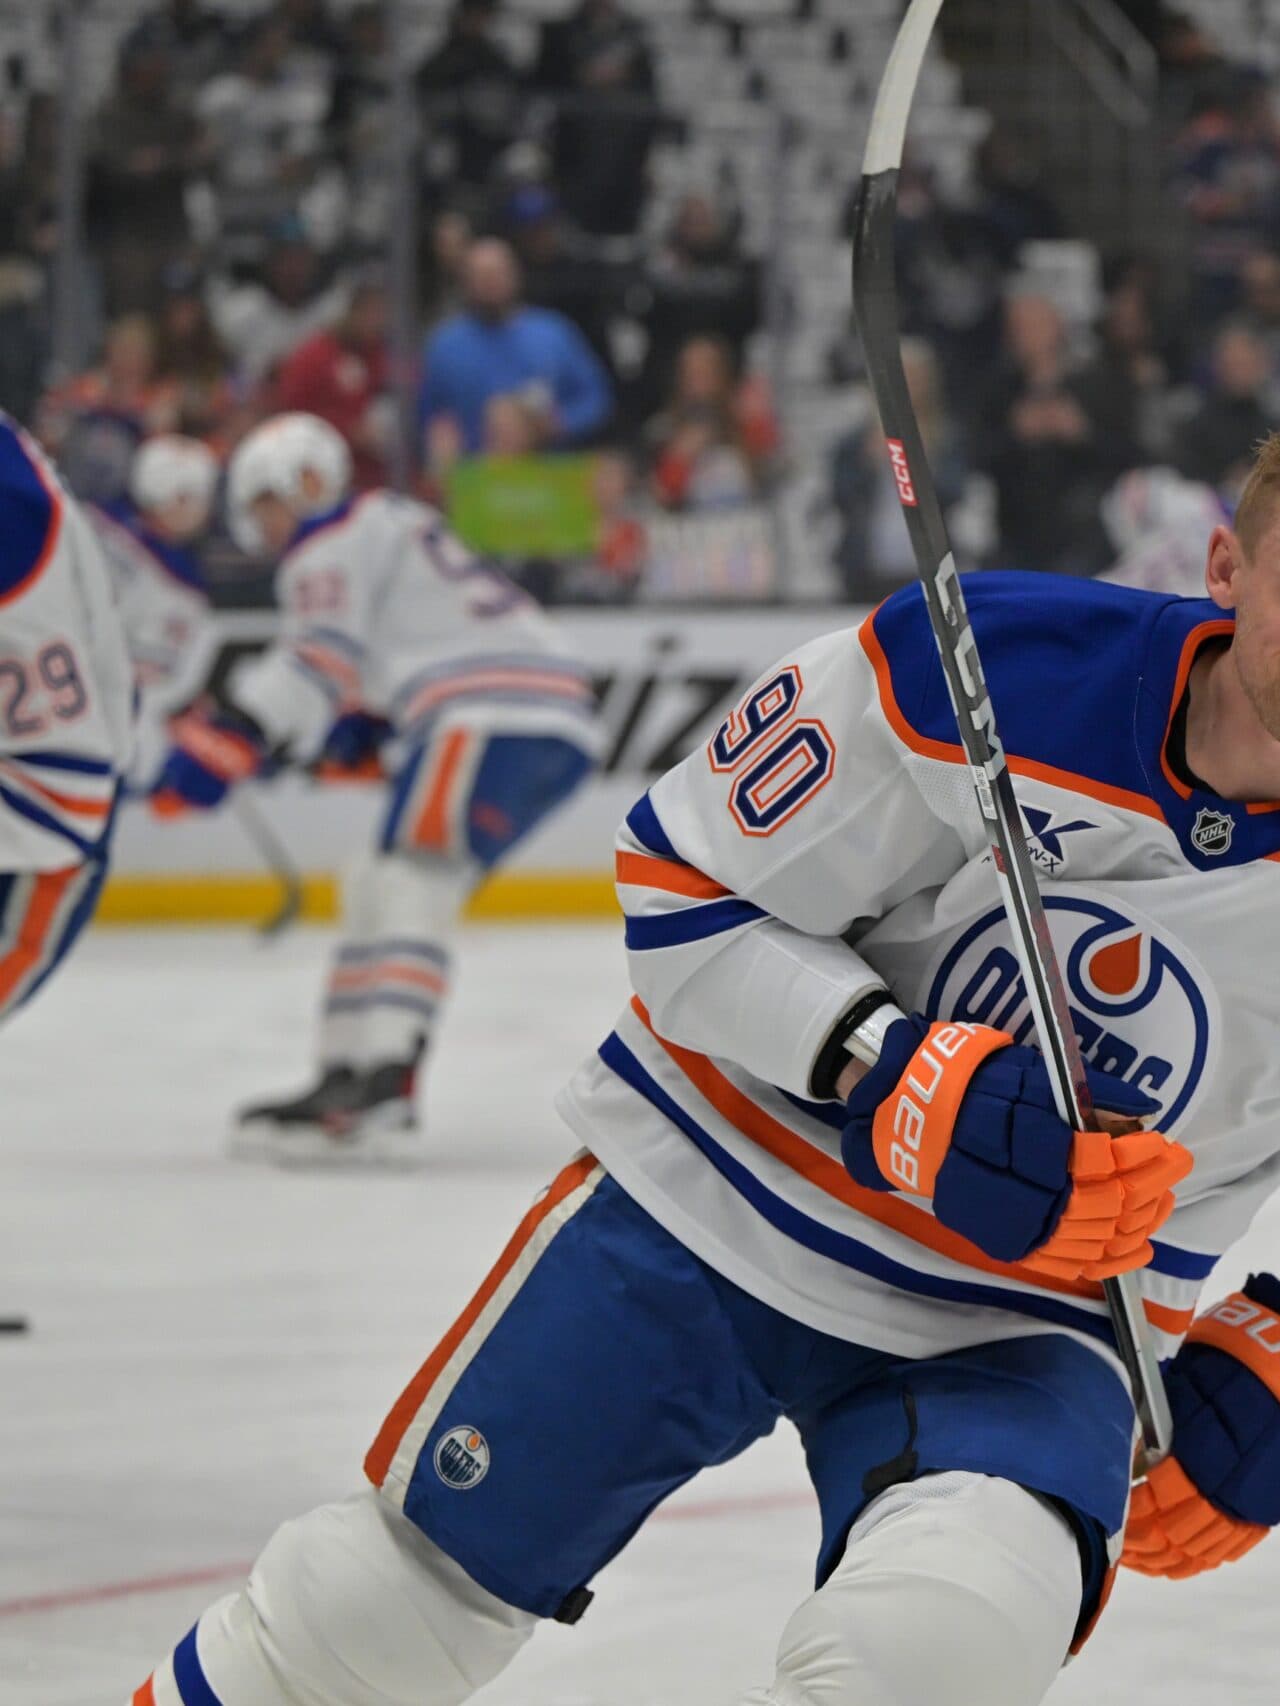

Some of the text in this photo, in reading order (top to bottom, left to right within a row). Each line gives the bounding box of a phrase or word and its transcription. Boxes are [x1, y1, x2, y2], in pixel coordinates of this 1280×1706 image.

[888, 442, 915, 502] CCM
[0, 640, 87, 736] 29
[707, 664, 836, 838] 90
[1199, 824, 1226, 842] NHL
